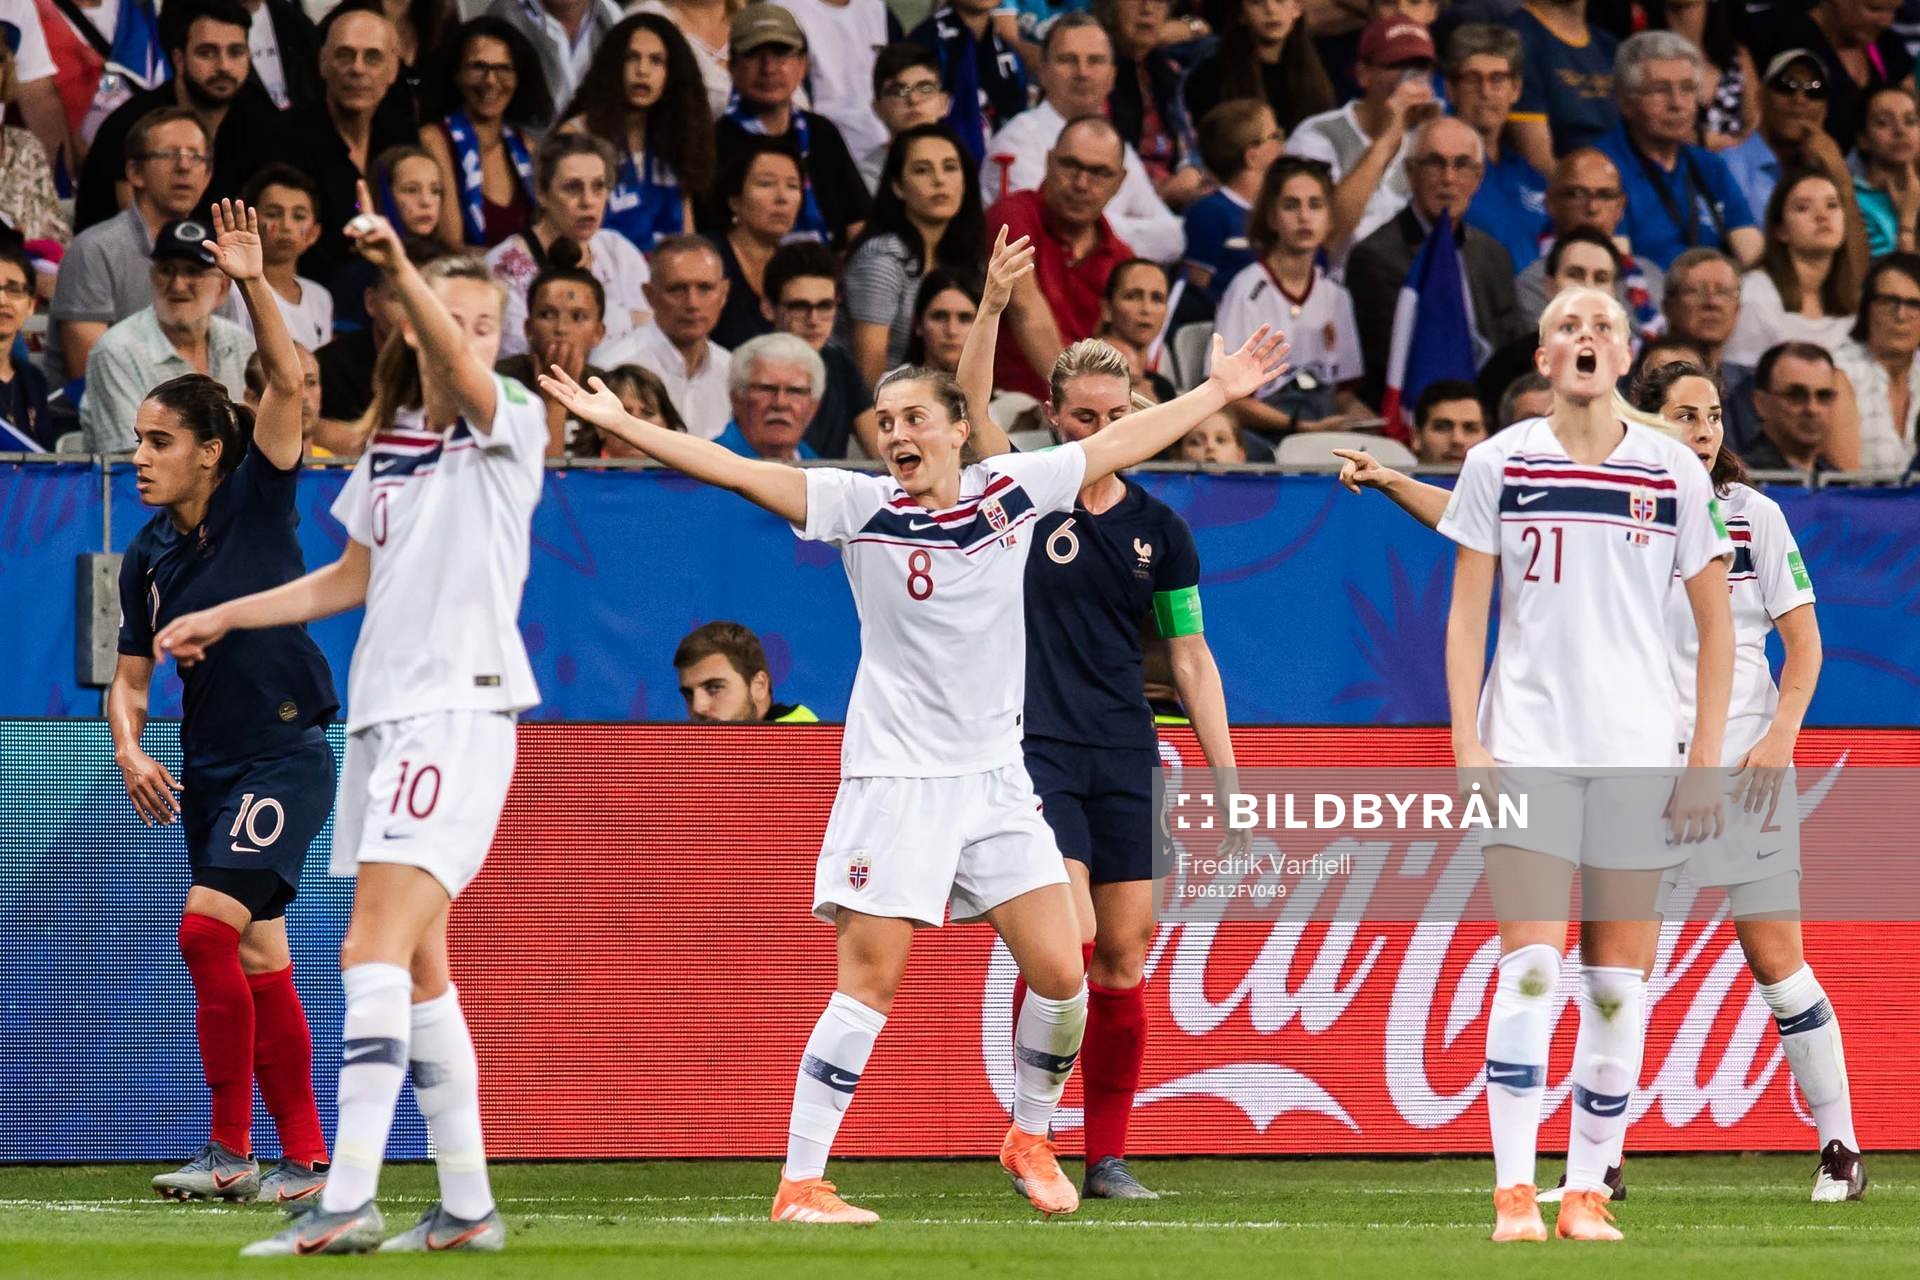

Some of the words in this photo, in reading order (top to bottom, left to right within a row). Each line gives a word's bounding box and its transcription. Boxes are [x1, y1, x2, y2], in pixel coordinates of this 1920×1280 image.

[371, 492, 387, 547] 0
[1046, 518, 1079, 564] 6
[907, 550, 934, 601] 8
[1521, 526, 1563, 584] 21
[391, 760, 441, 820] 10
[229, 793, 285, 847] 10
